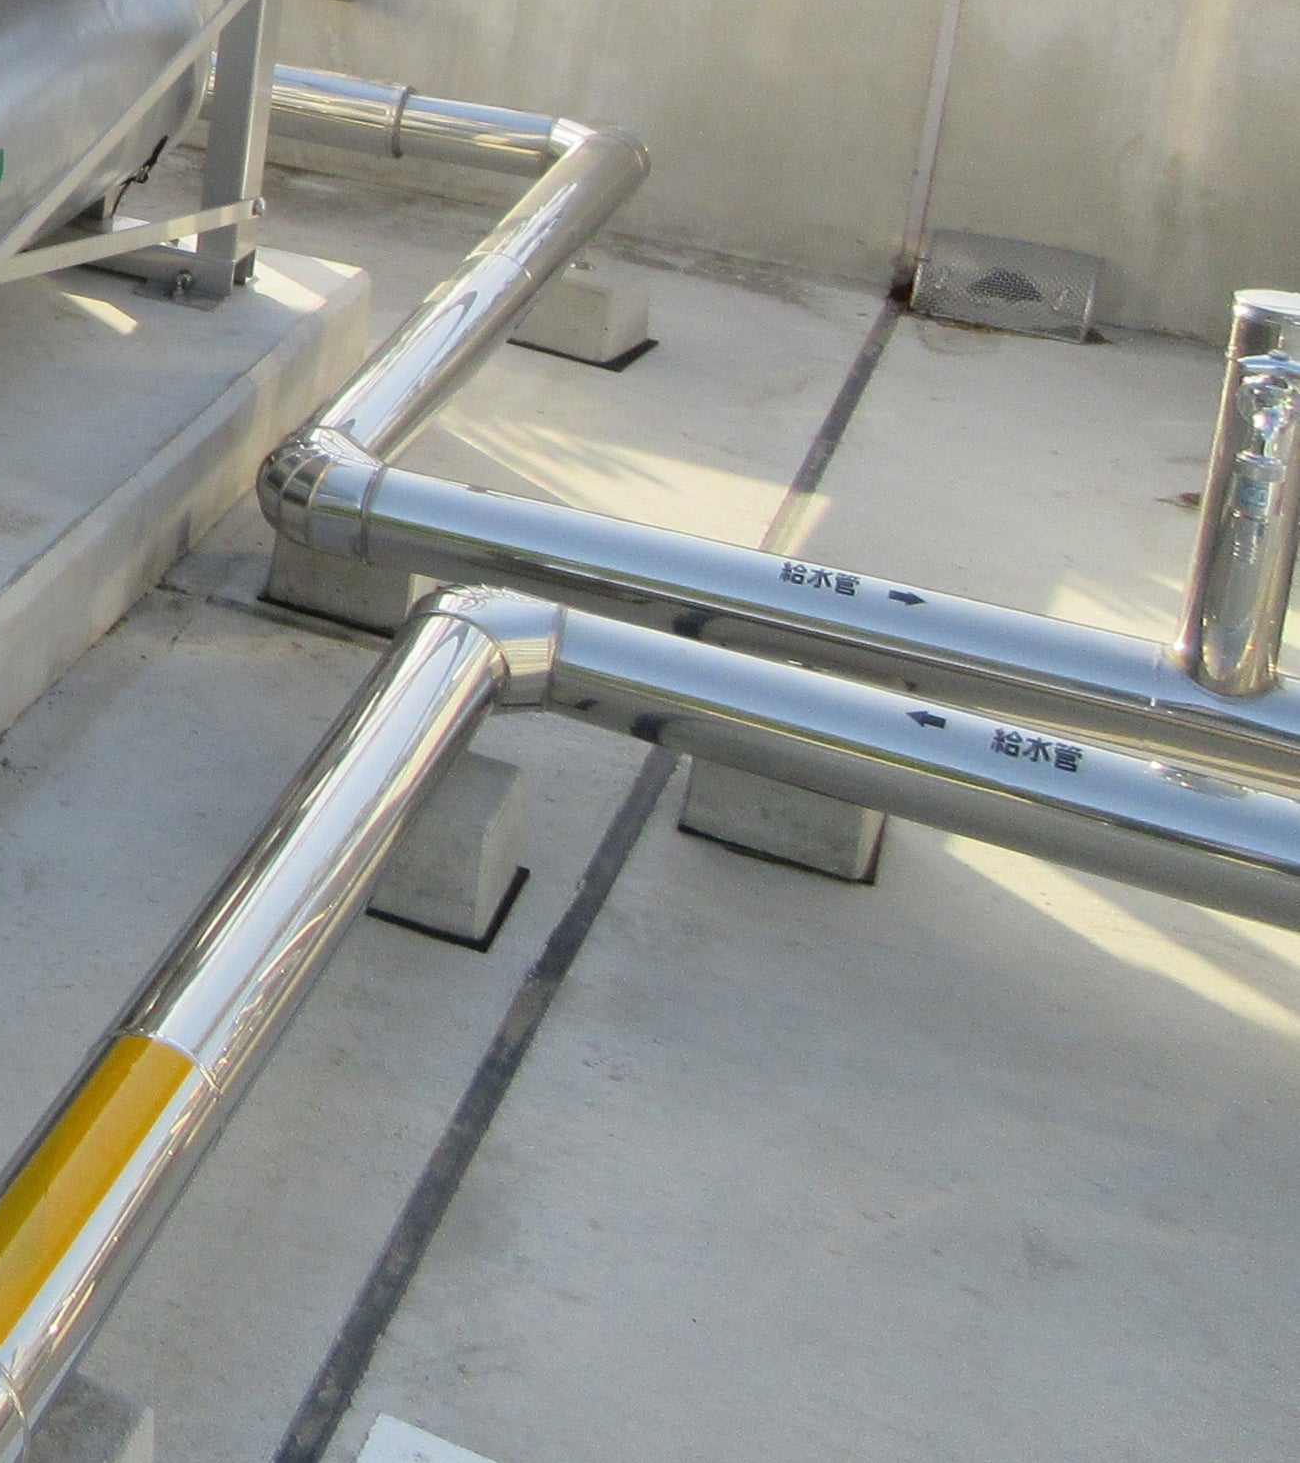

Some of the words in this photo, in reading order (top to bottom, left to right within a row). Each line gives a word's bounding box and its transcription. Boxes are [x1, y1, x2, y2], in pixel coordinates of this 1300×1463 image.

[778, 561, 861, 597] 給水管
[989, 728, 1084, 773] 給水管
